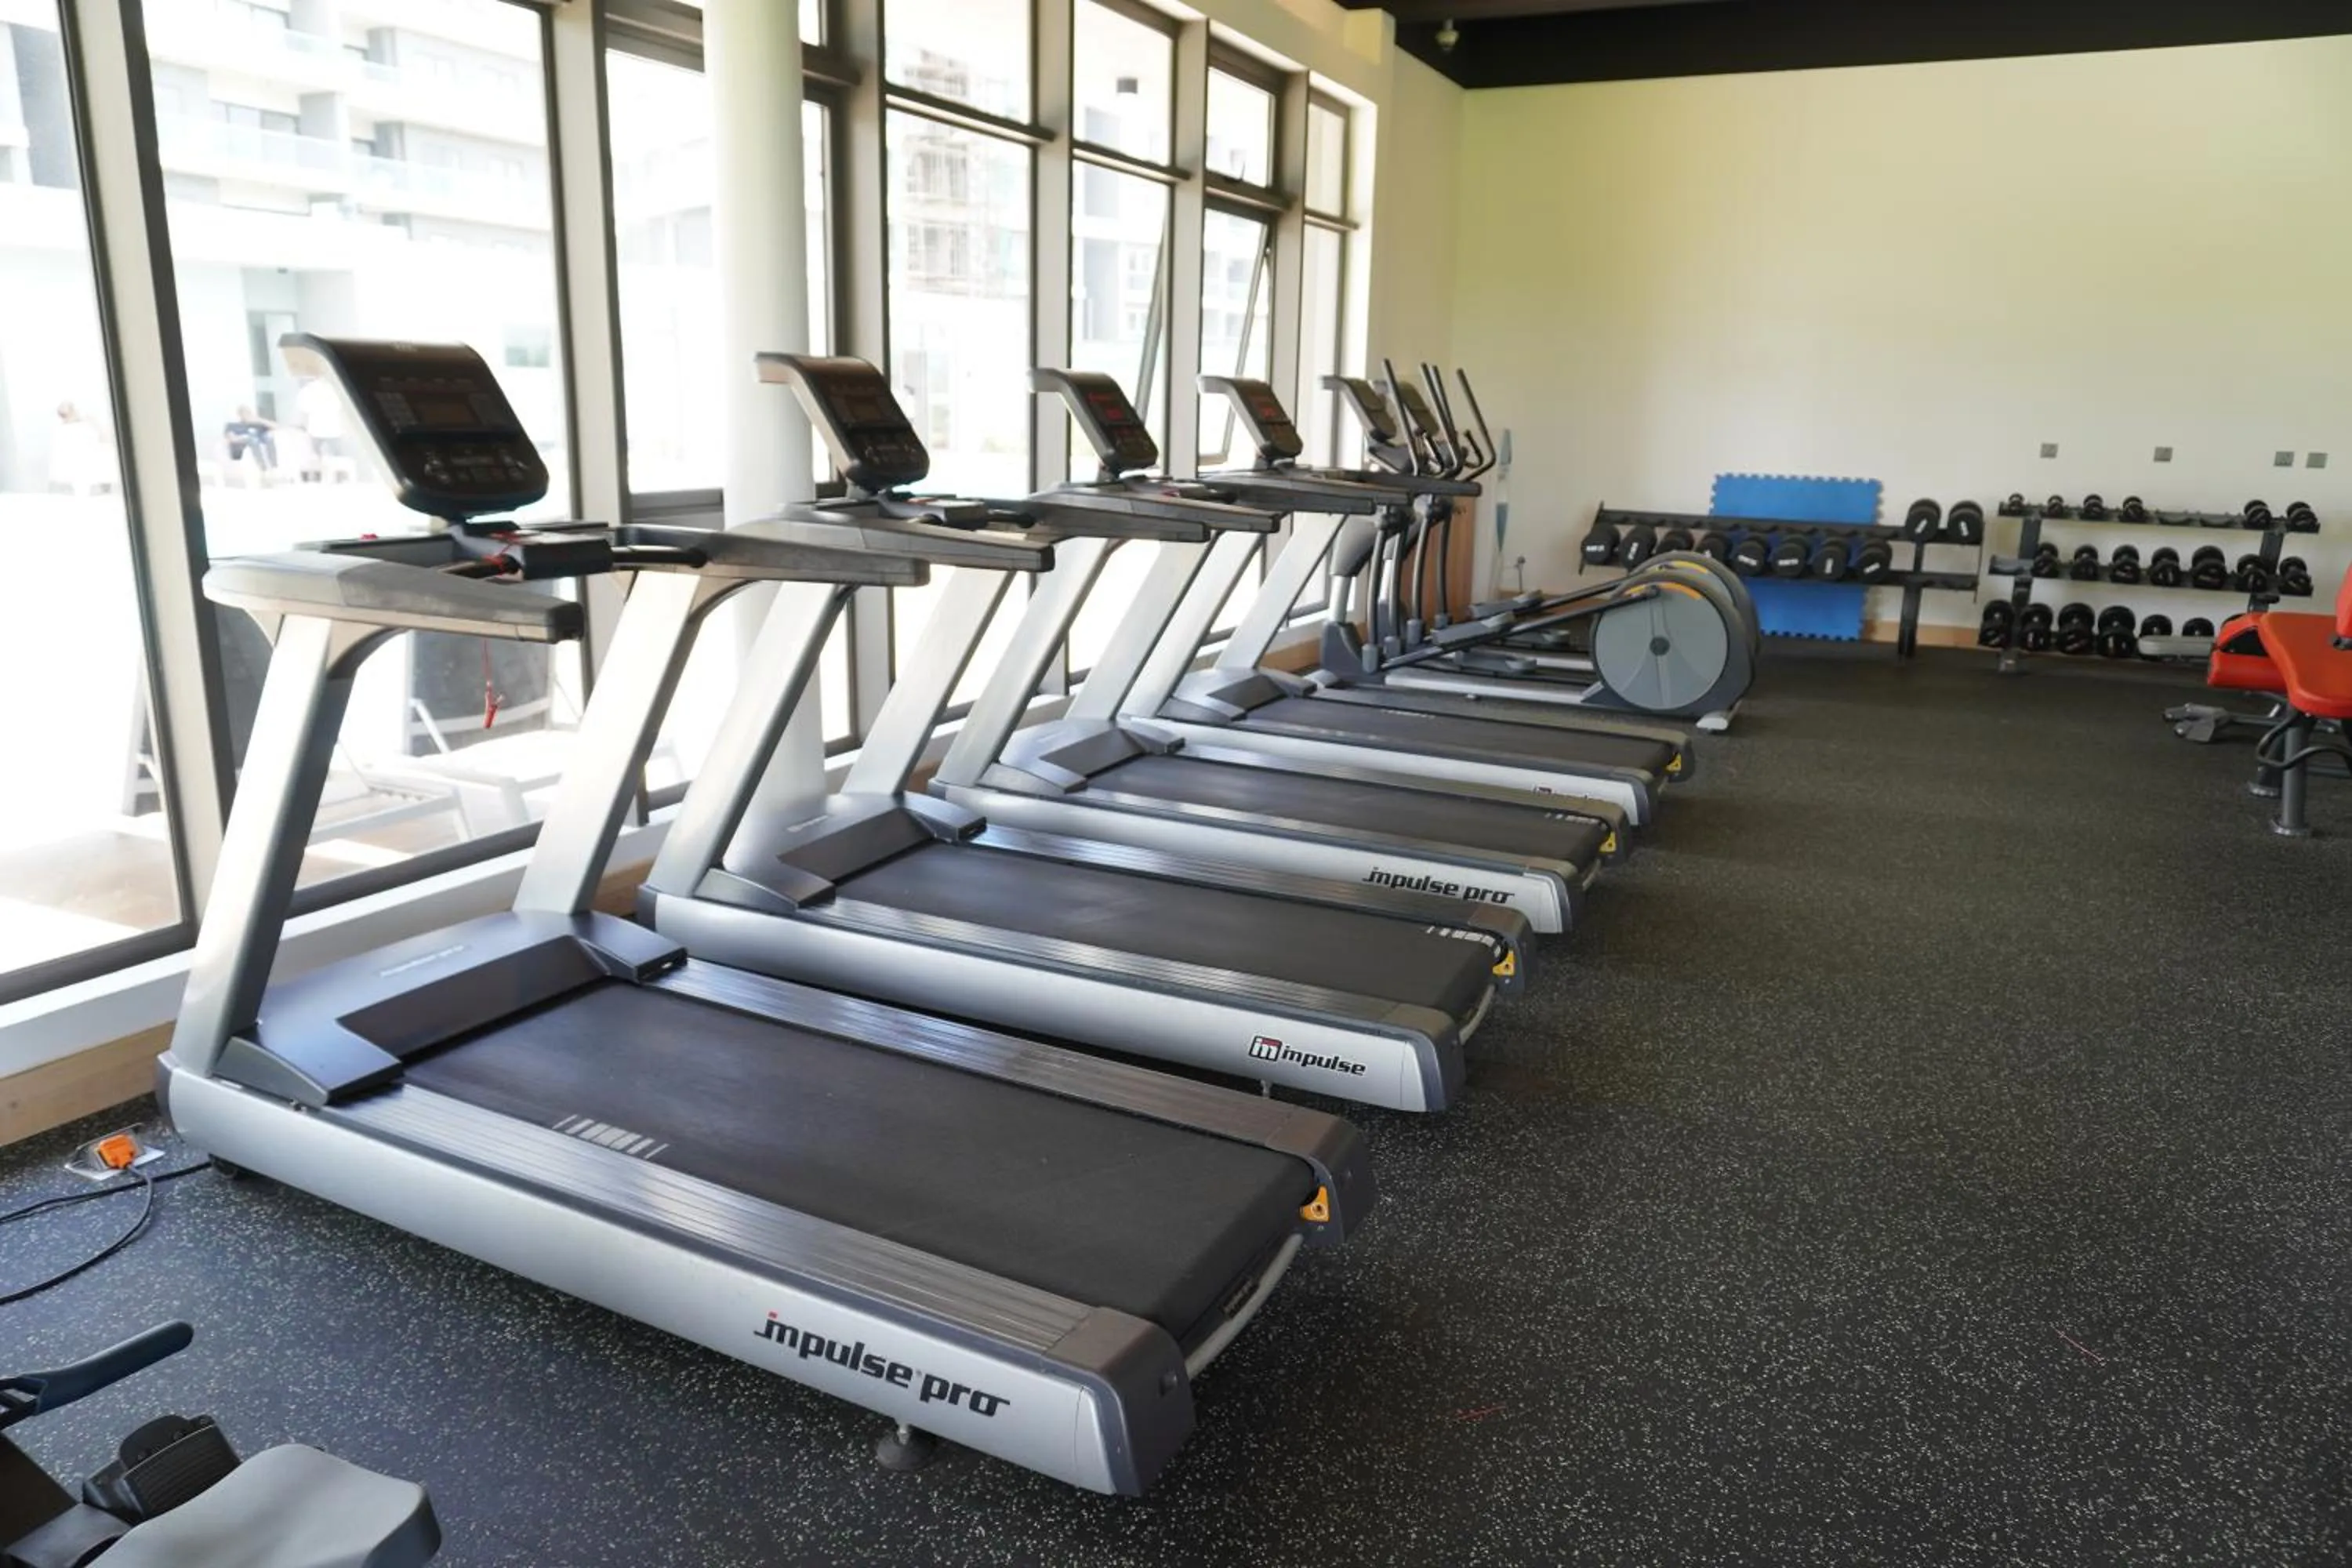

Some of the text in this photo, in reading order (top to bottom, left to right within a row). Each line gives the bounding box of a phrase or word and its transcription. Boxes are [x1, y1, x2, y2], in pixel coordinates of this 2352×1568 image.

[1362, 866, 1515, 904] impulse pro
[1281, 1045, 1367, 1076] impulse
[753, 1310, 1011, 1417] impulse pro
